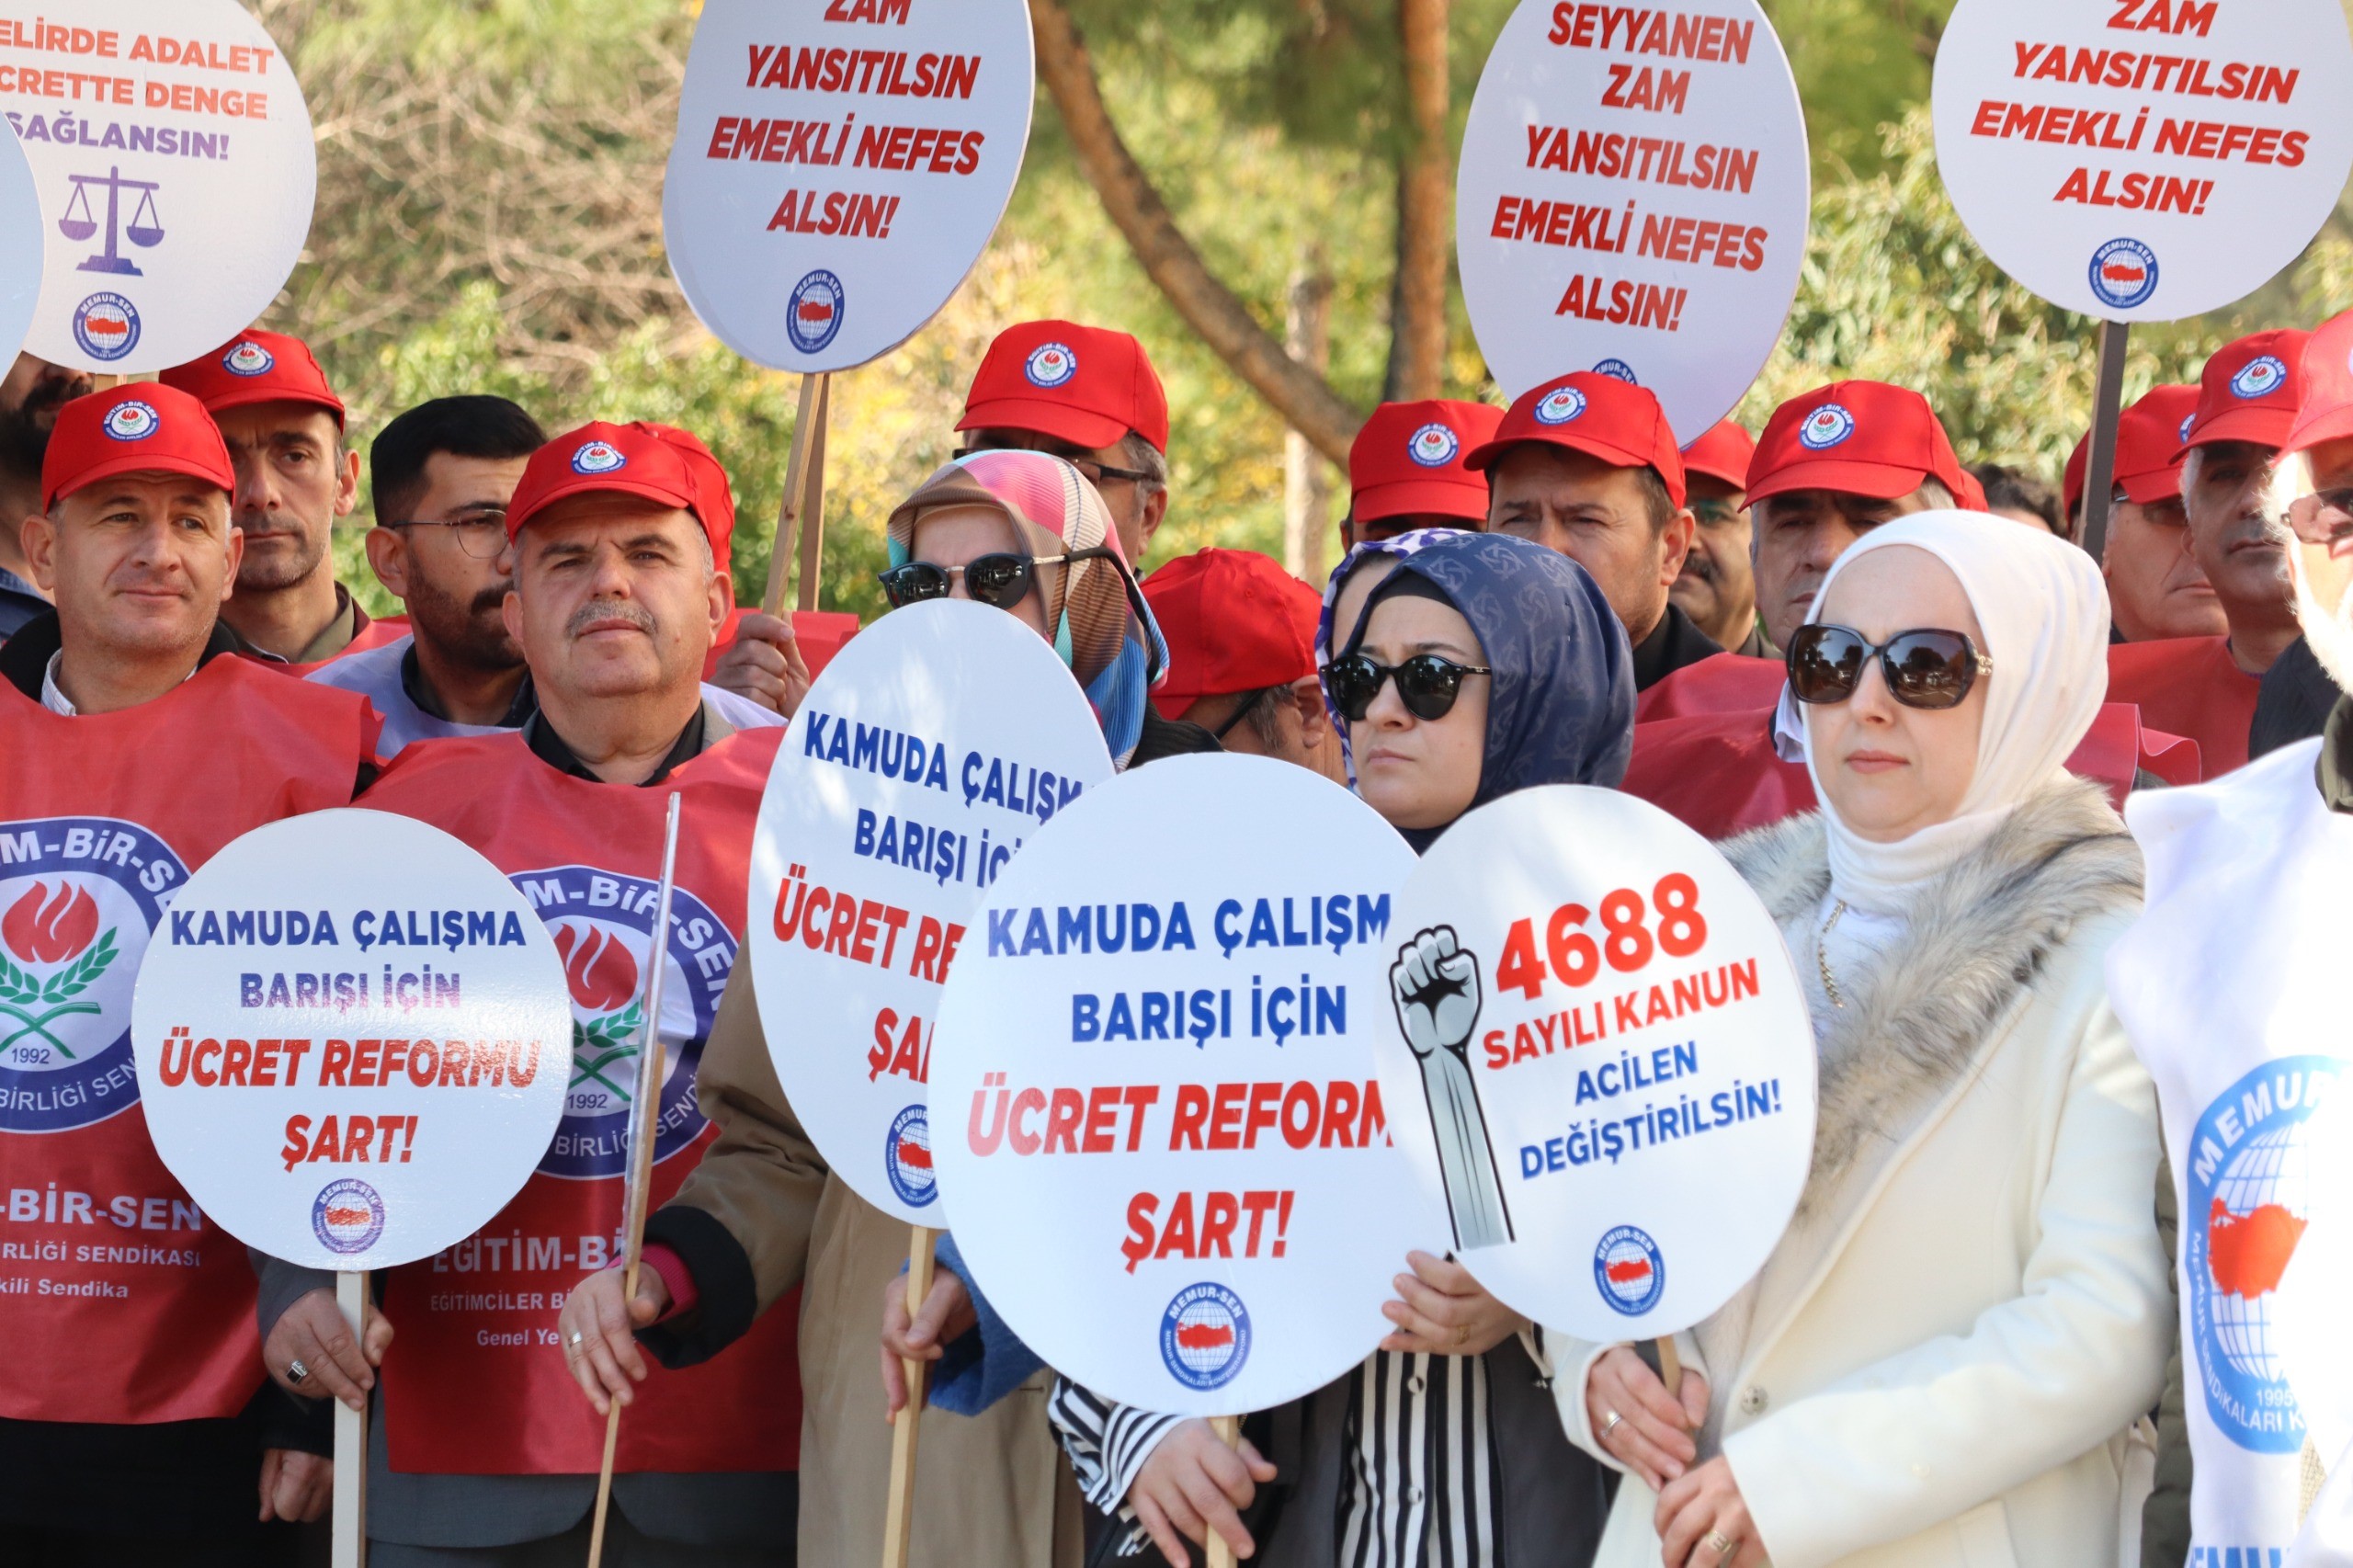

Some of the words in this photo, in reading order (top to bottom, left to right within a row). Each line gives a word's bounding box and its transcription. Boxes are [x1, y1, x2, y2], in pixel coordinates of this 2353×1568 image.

[1548, 2, 1755, 64] SEYYANEN
[2106, 0, 2220, 38] ZAM
[129, 34, 274, 74] ADALET
[746, 44, 982, 100] YANSITILSIN
[2014, 41, 2301, 104] YANSITILSIN
[145, 81, 267, 120] DENGE
[1601, 63, 1691, 115] ZAM
[5, 108, 231, 161] SAĞLANSIN!
[707, 112, 855, 166] EMEKLİ
[853, 125, 985, 176] NEFES
[1527, 125, 1759, 194] YANSITILSIN
[1970, 99, 2150, 151] EMEKLİ
[2154, 119, 2311, 167] NEFES
[766, 189, 901, 239] ALSIN!
[2052, 167, 2215, 215] ALSIN!
[1490, 195, 1635, 254] EMEKLİ
[1637, 214, 1768, 272] NEFES
[1555, 274, 1688, 332] ALSIN!
[804, 710, 949, 792] KAMUDA
[962, 751, 1088, 826] ÇALIŞM
[854, 808, 968, 888] BARIŞI
[170, 910, 339, 946] KAMUDA
[352, 910, 527, 953] ÇALIŞMA
[773, 863, 909, 969] ÜCRET
[988, 901, 1197, 958] KAMUDA
[1214, 892, 1392, 960] ÇALIŞM
[1495, 872, 1708, 1002] 4688
[240, 972, 369, 1015] BARIŞI
[383, 963, 460, 1013] İÇİN
[1072, 988, 1232, 1049] BARIŞI
[1251, 973, 1347, 1047] İÇİN
[1483, 1001, 1608, 1070] SAYILI
[1614, 958, 1761, 1034] KANUN
[11, 1047, 51, 1064] 1992
[158, 1027, 311, 1087] ÜCRET
[318, 1039, 541, 1088] REFORMU
[1574, 1040, 1699, 1107] ACİLEN
[568, 1093, 608, 1109] 1992
[967, 1072, 1159, 1157] ÜCRET
[1169, 1080, 1394, 1151] REFORM
[1519, 1079, 1783, 1181] DEĞİŞTİRİLSİN!
[280, 1115, 419, 1173] ŞART!
[76, 1244, 200, 1267] SENDİKASI
[1120, 1190, 1295, 1275] ŞART!
[1597, 1229, 1654, 1260] MEMUR-SEN
[38, 1278, 129, 1299] Sendika
[1169, 1286, 1244, 1320] MEMUR-SEN
[477, 1329, 529, 1346] Genel
[2256, 1388, 2294, 1407] 1995
